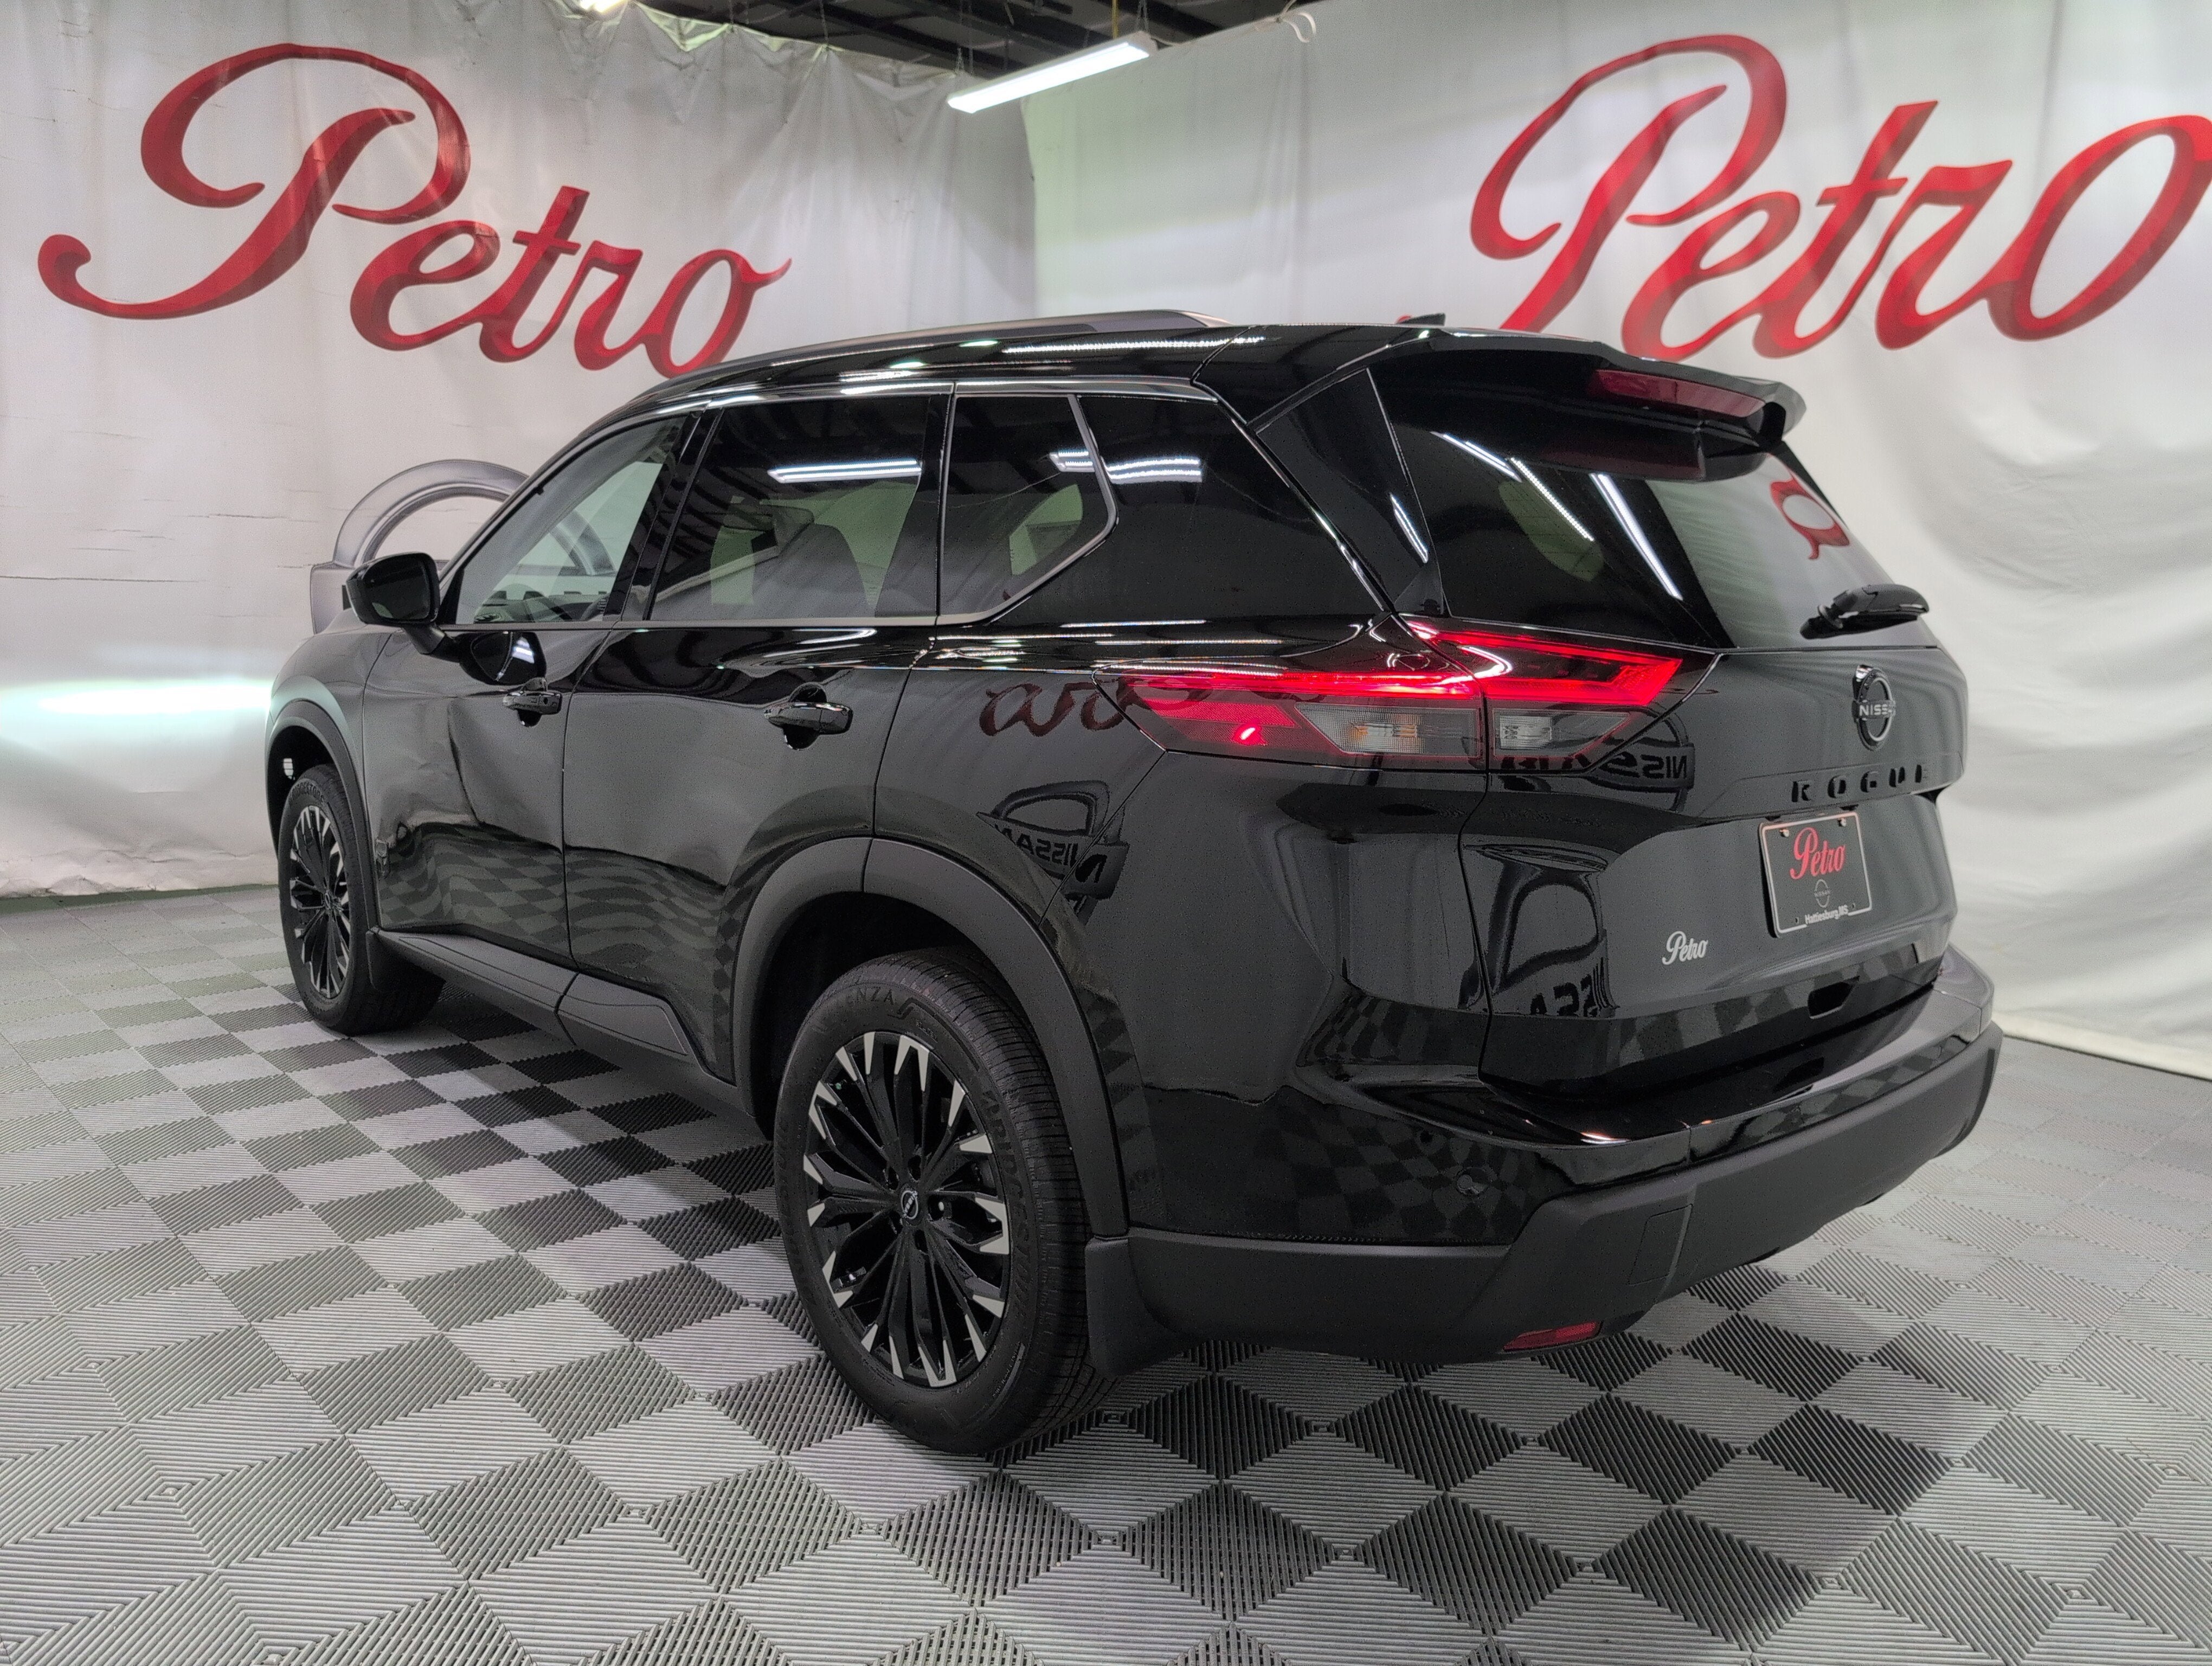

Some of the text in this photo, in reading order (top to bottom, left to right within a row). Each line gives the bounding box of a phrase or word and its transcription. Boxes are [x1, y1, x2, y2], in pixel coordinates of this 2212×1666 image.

[37, 43, 792, 379] Petro
[1470, 34, 2212, 360] Petro
[1859, 703, 1895, 716] NISS
[1789, 827, 1846, 880] Petro
[1661, 931, 1708, 965] Petro
